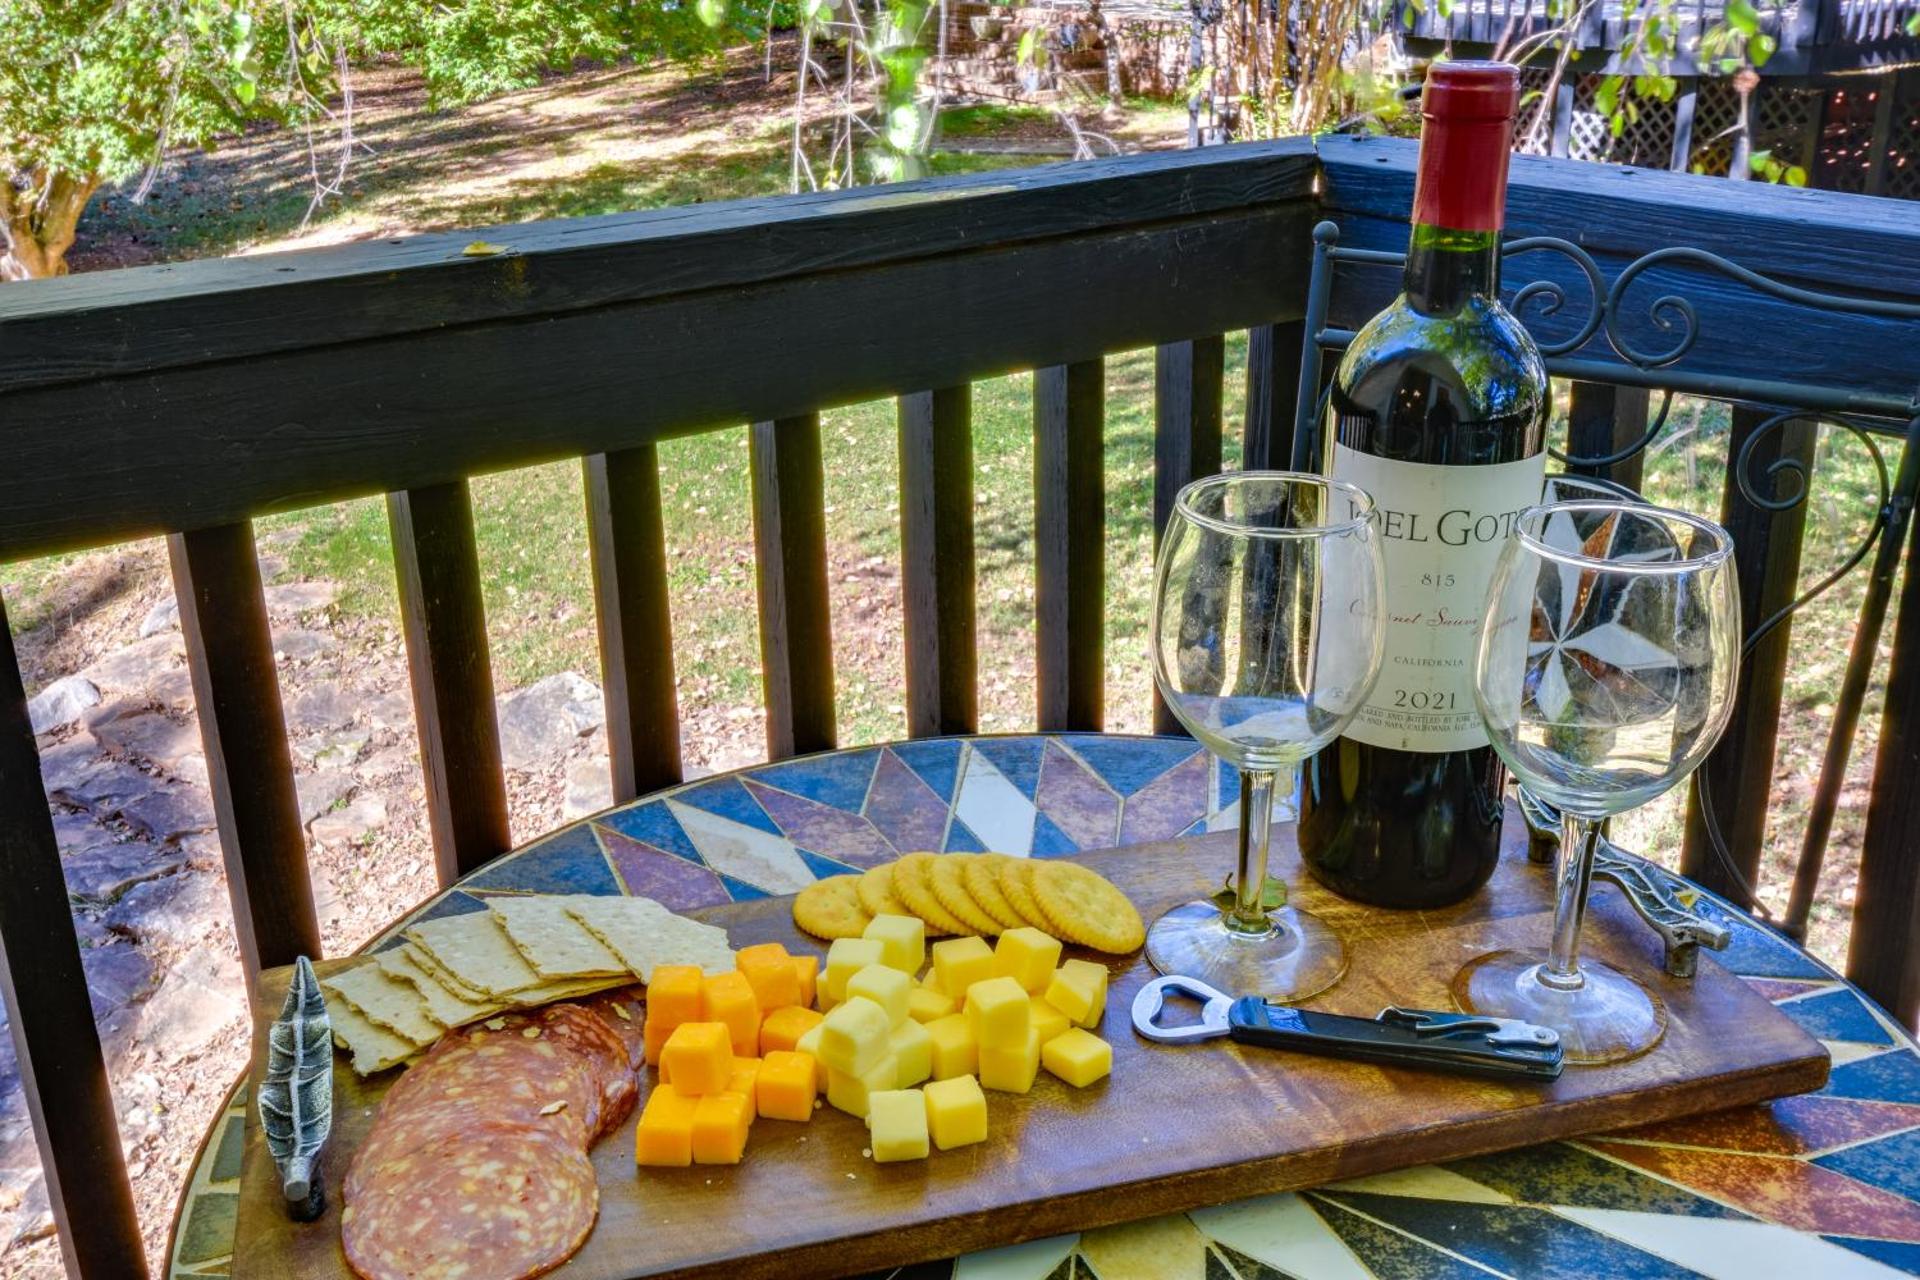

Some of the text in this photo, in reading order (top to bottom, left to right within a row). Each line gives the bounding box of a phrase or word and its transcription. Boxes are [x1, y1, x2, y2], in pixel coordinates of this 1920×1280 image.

[1421, 573, 1455, 589] 815
[1394, 656, 1464, 667] CALIFORNIA
[1395, 690, 1455, 710] 2021
